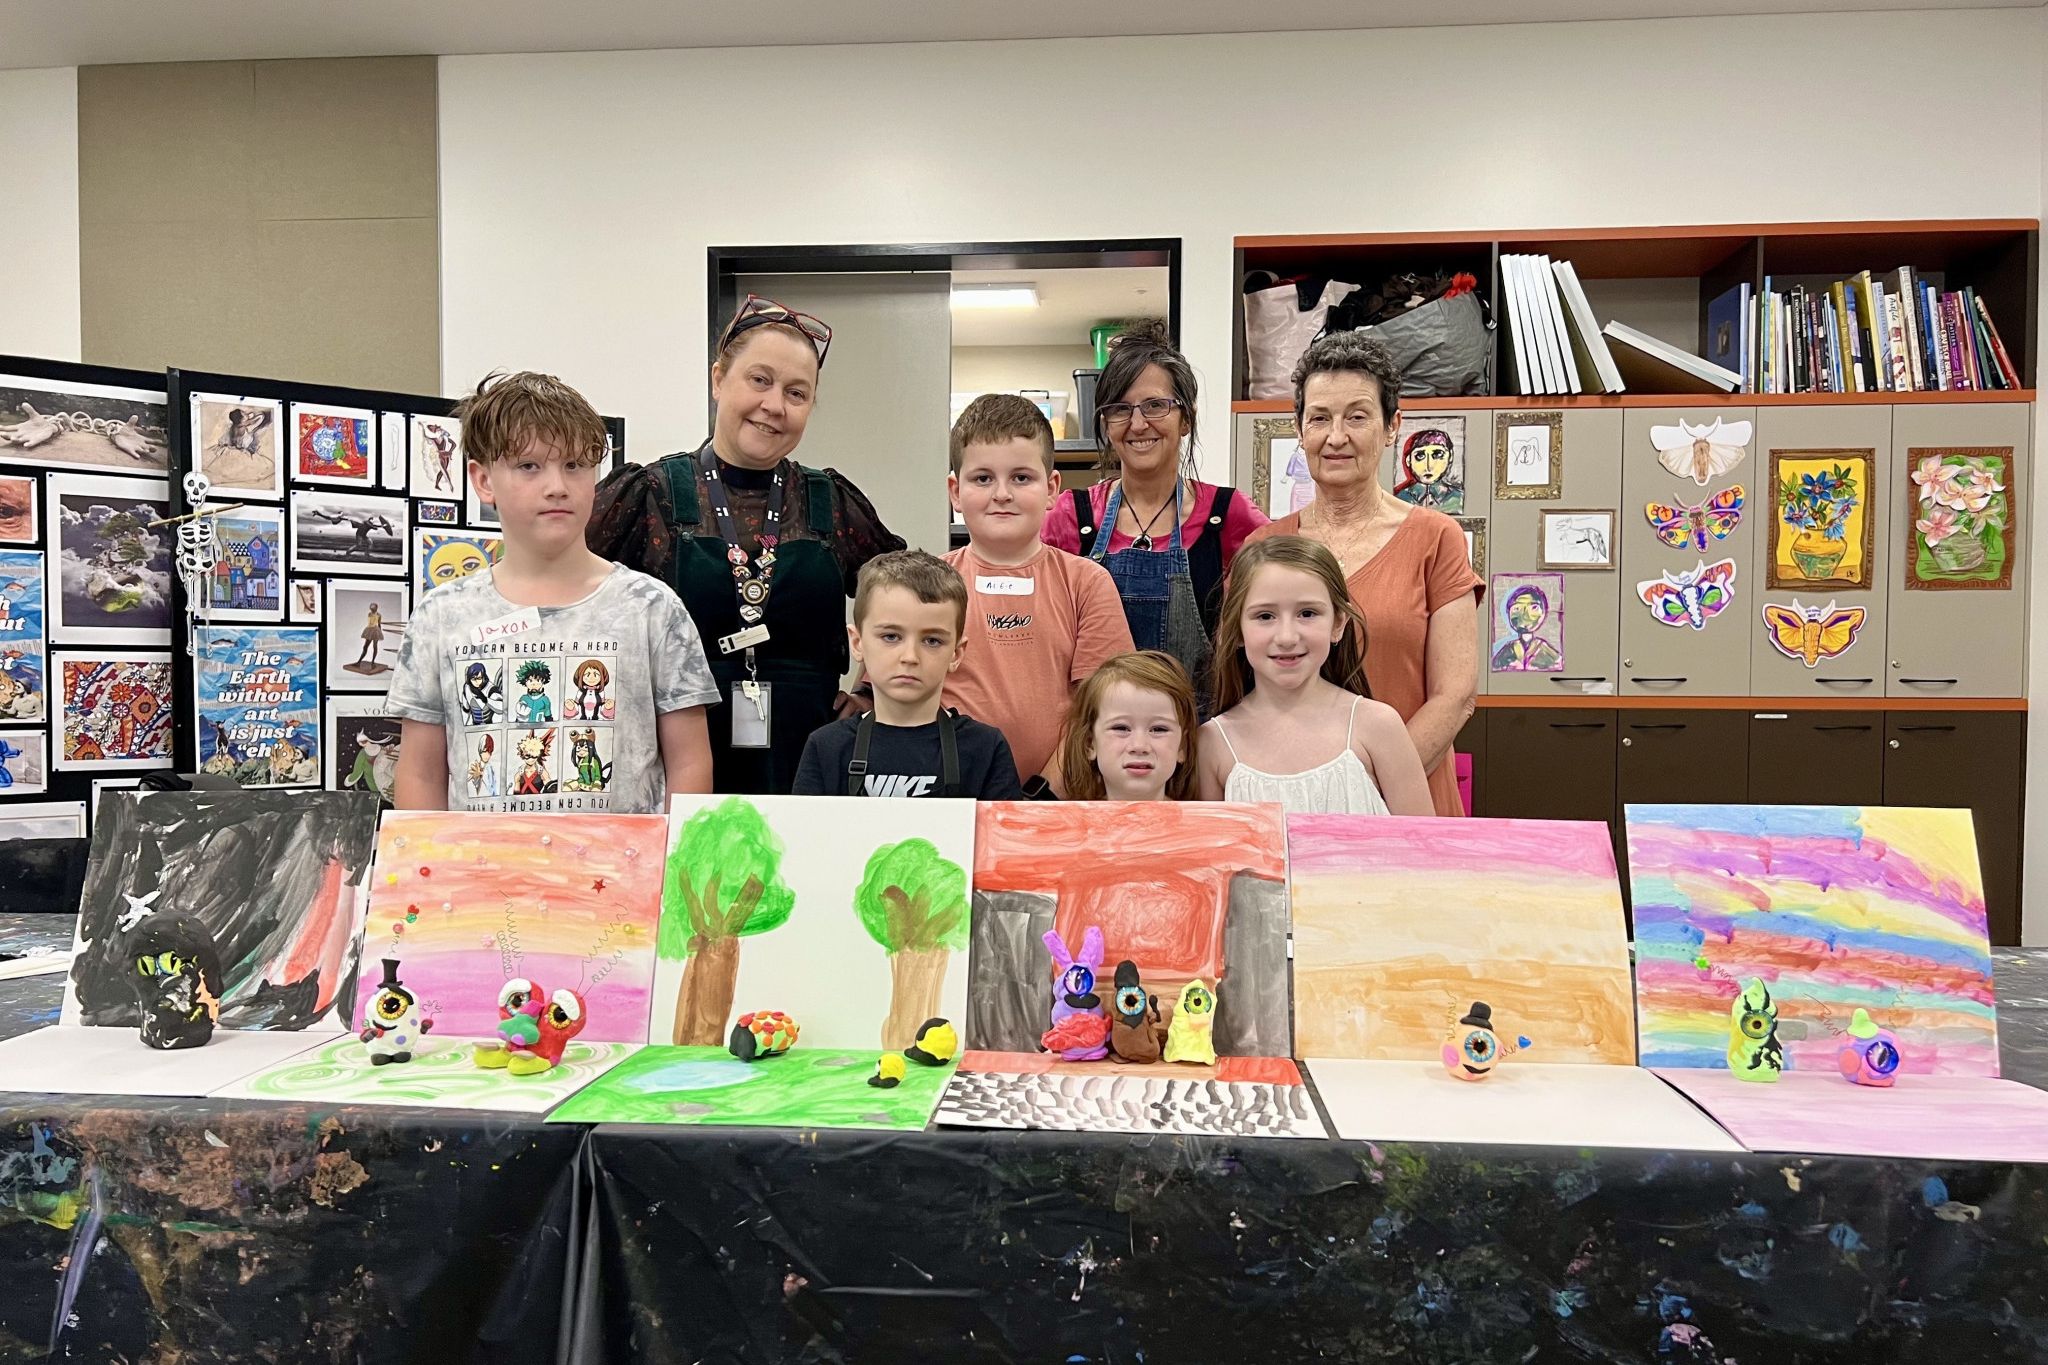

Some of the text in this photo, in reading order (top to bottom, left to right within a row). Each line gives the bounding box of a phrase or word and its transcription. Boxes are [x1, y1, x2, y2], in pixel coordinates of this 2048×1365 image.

[455, 641, 619, 656] YOU CAN BECOME A HERO
[241, 651, 282, 666] The
[229, 669, 291, 685] Earth
[217, 687, 304, 703] without
[244, 707, 279, 721] art
[228, 725, 295, 743] is just
[864, 774, 938, 798] NIKE
[502, 800, 552, 813] BECOME
[558, 798, 583, 809] CAN
